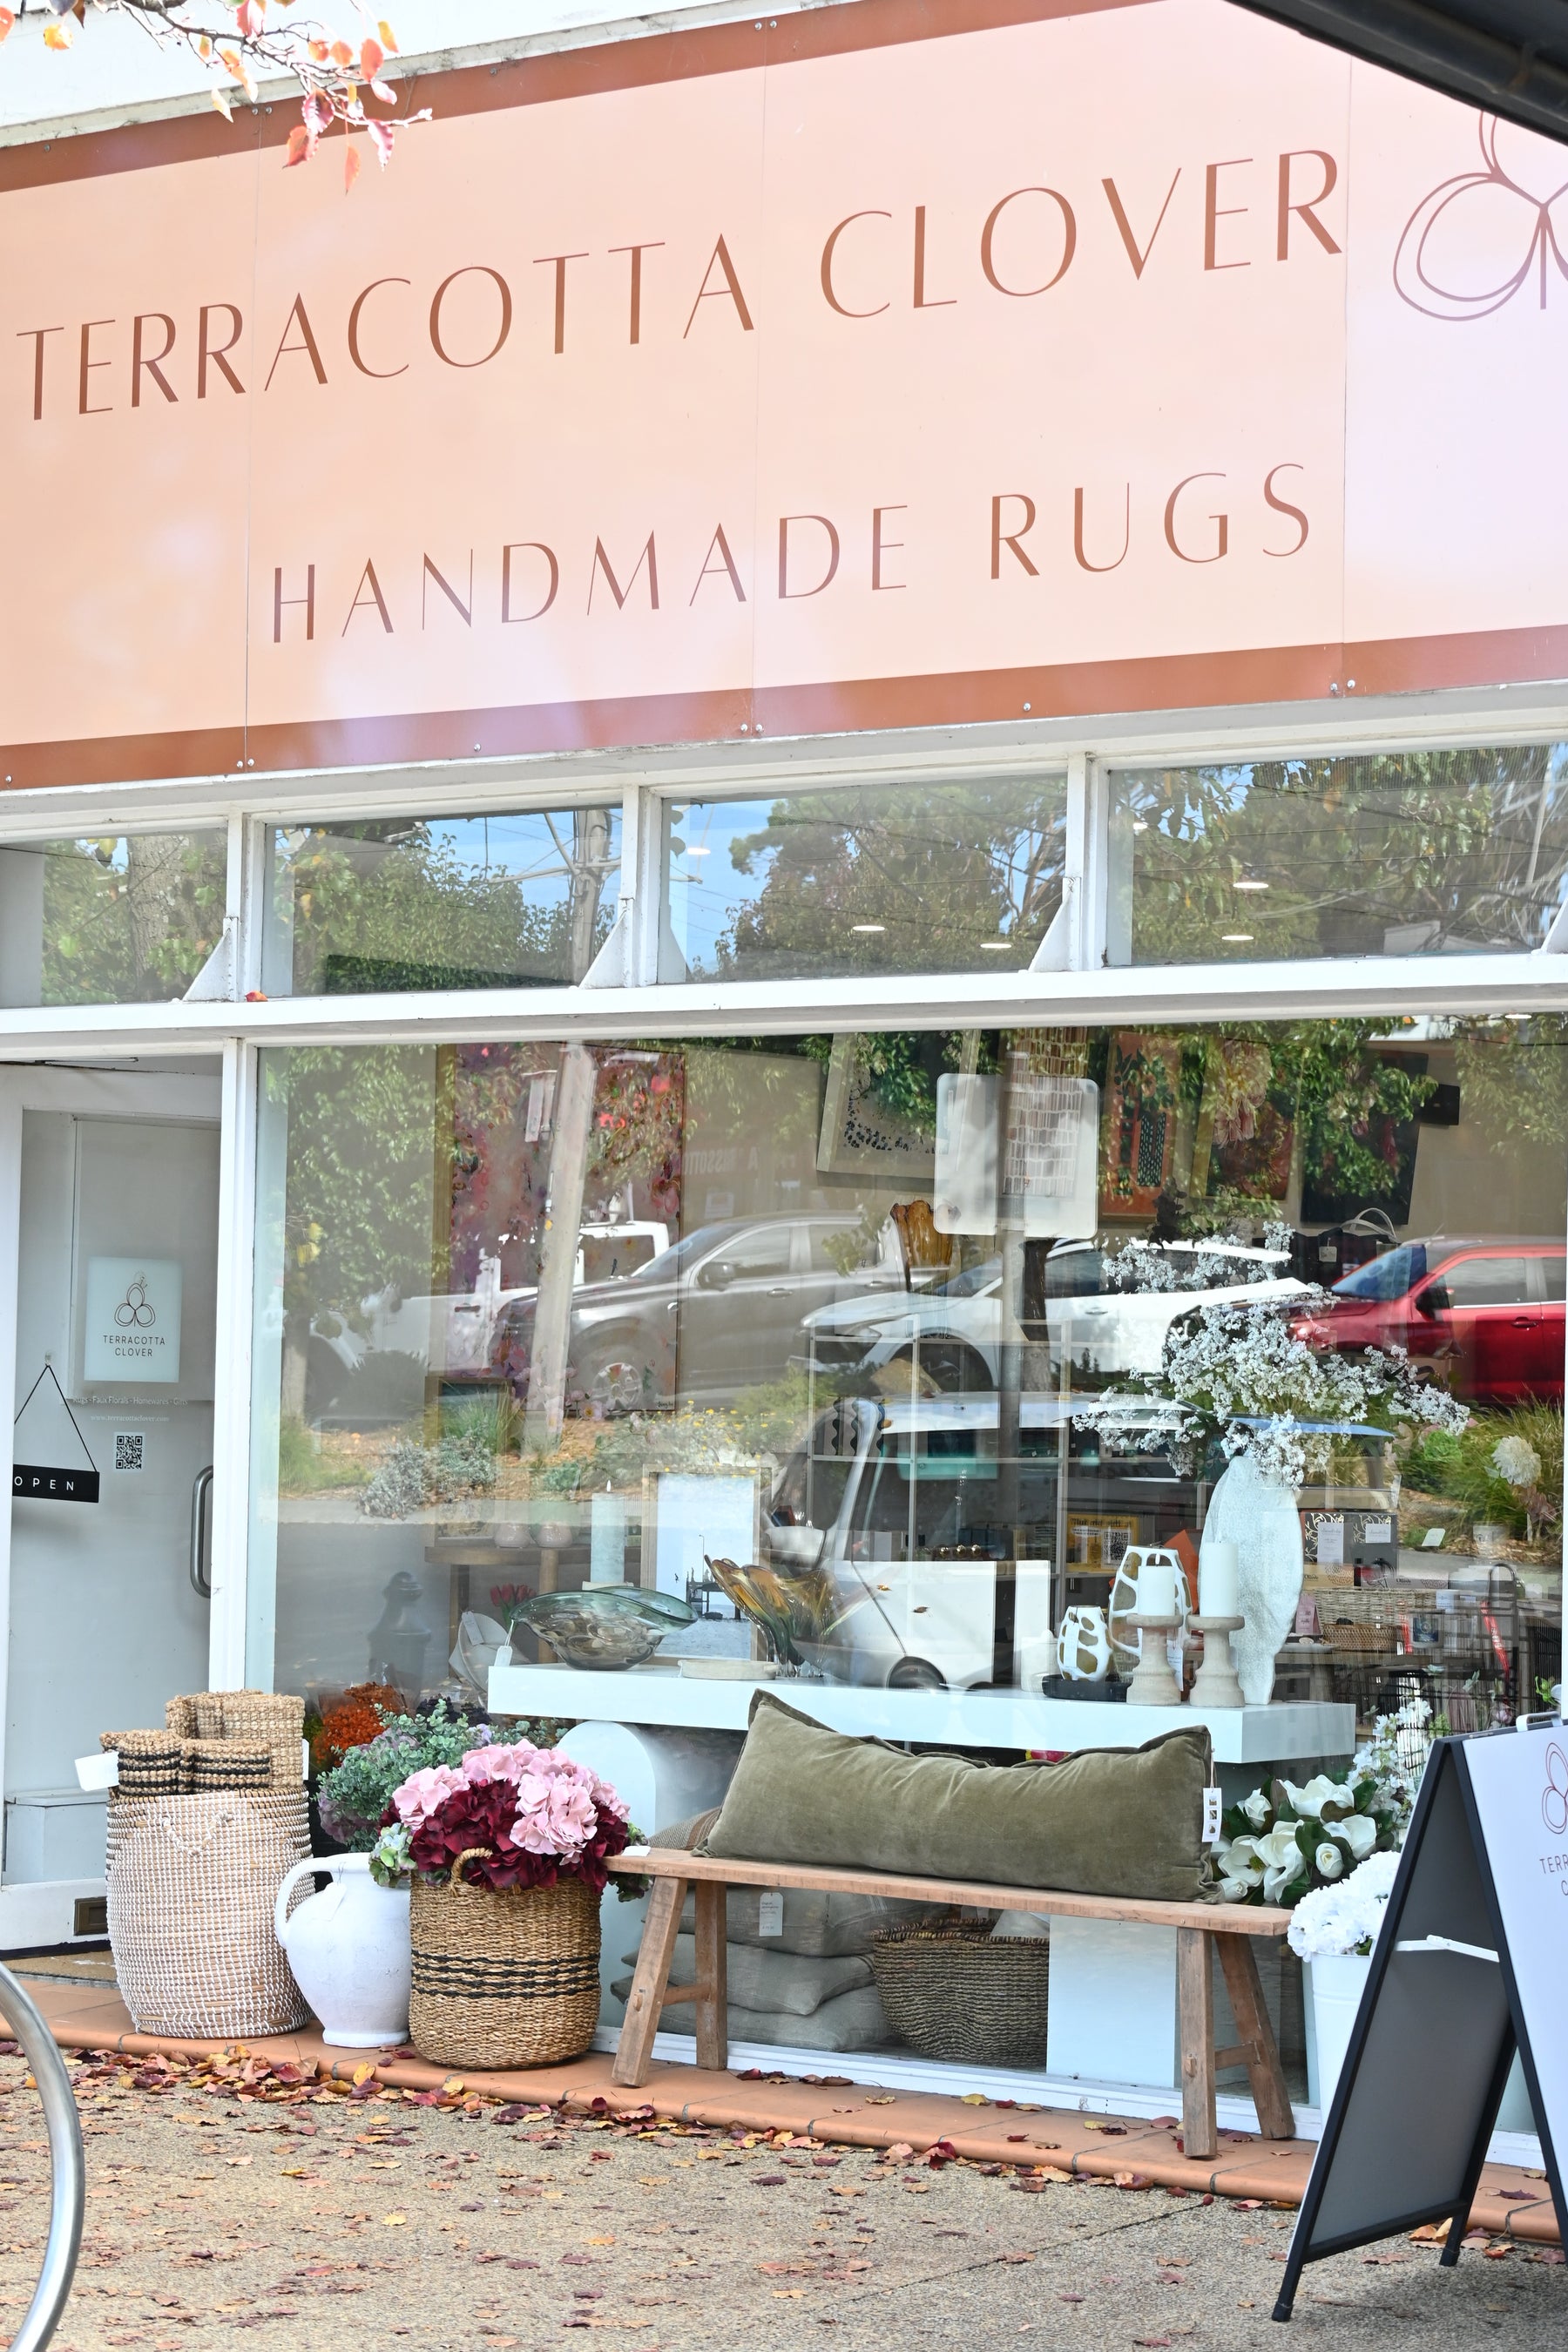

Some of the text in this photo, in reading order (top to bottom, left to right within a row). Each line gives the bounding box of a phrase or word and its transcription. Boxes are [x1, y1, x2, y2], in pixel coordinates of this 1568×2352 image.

[16, 150, 1342, 421] TERRACOTTA CLOVER
[274, 463, 1309, 644] HANDMADE RUGS
[103, 1335, 166, 1346] TERRACOTTA
[114, 1348, 153, 1357] CLOVER
[14, 1476, 74, 1491] OPEN
